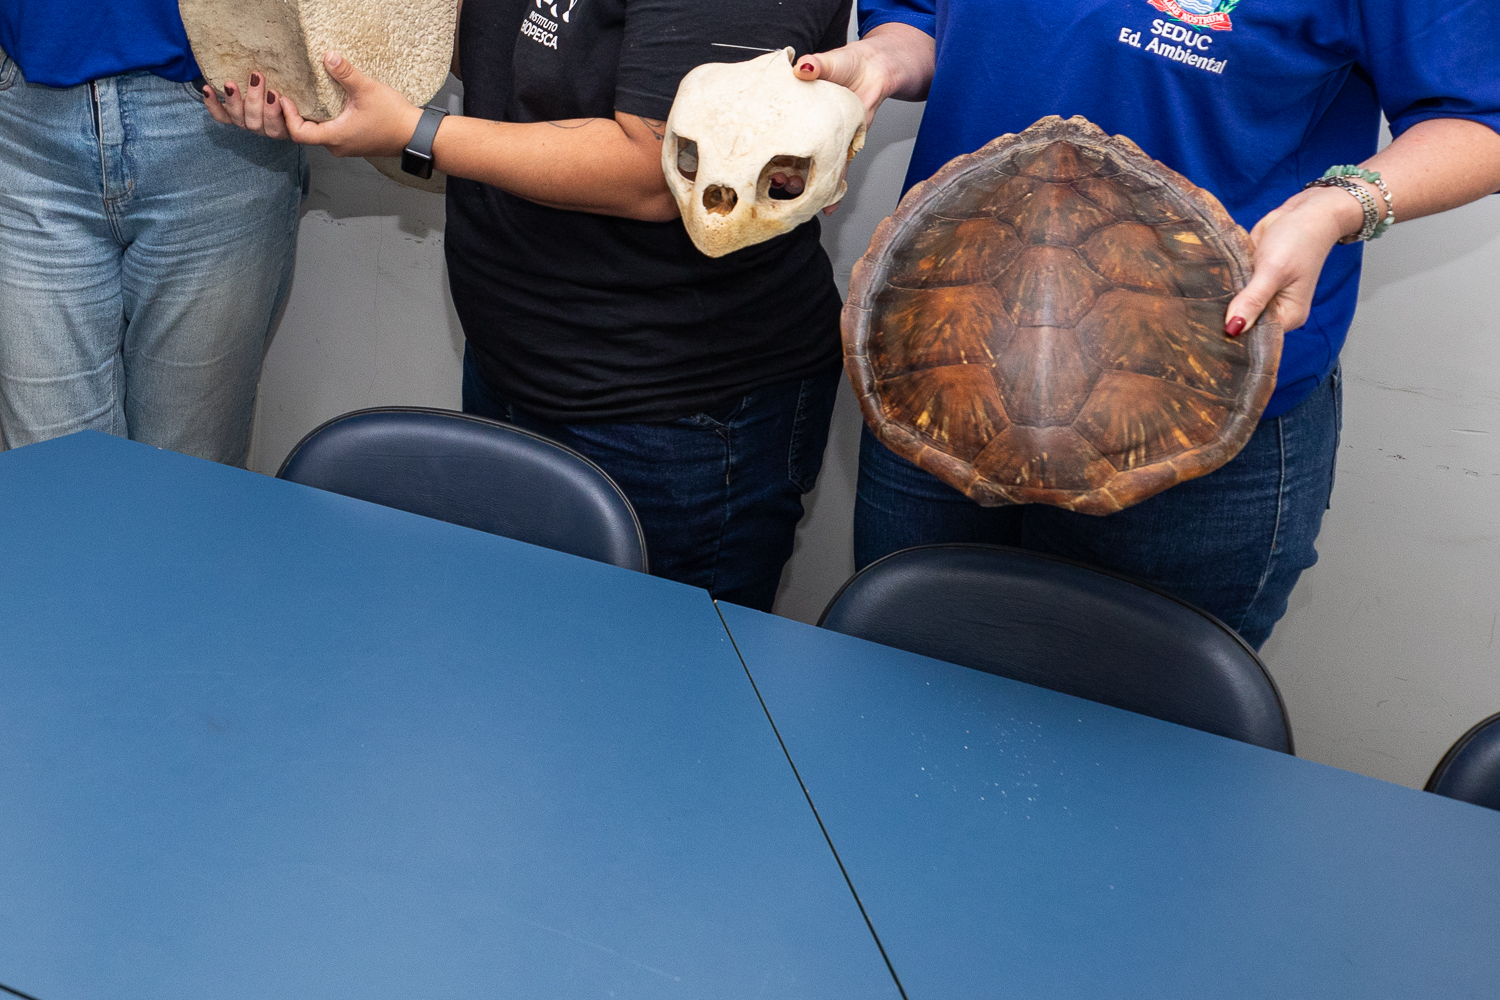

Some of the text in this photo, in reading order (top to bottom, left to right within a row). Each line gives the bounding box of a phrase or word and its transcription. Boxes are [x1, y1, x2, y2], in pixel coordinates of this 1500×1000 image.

[529, 11, 558, 32] INSTITUTO
[1181, 13, 1224, 24] NOSTRUM
[521, 19, 558, 50] BIOPESCA
[1150, 19, 1213, 50] SEDUC
[1118, 27, 1228, 74] Ed. Ambiental
